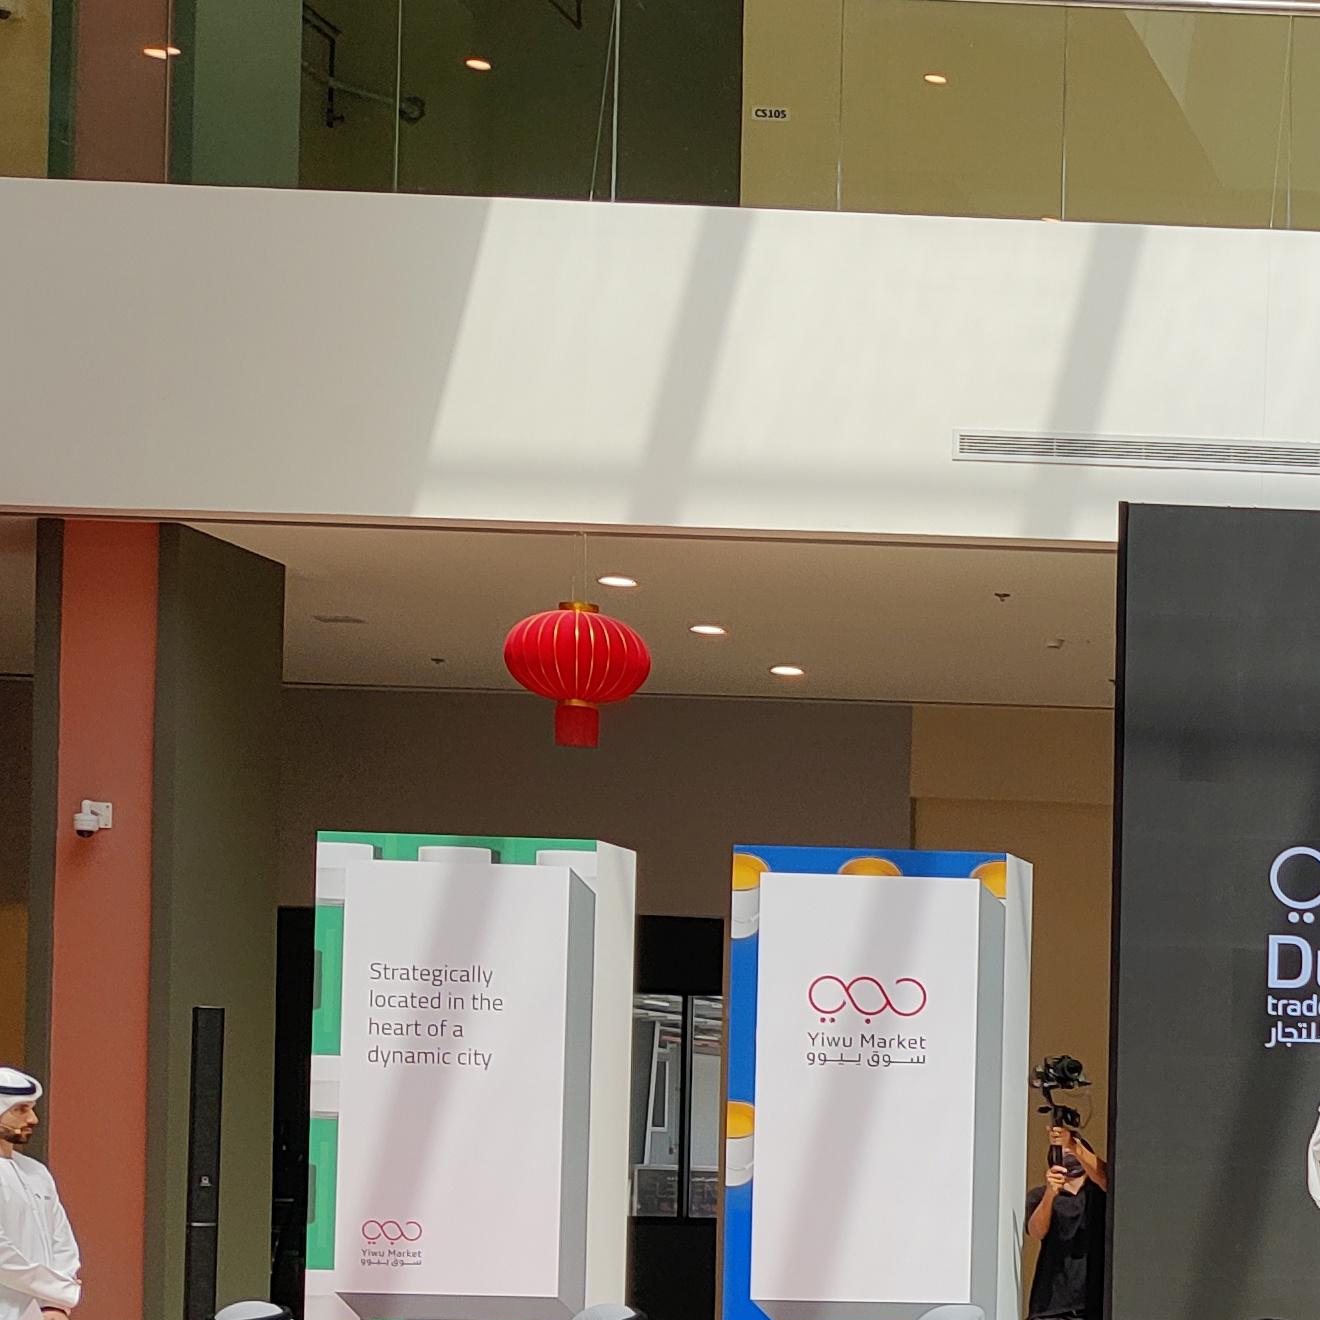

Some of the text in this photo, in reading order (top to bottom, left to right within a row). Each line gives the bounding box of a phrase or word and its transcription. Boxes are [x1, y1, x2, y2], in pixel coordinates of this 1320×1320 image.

[754, 108, 787, 118] CS105
[370, 962, 493, 988] Strategically
[369, 989, 503, 1011] located in the
[368, 1017, 464, 1038] heart of a
[807, 1032, 926, 1049] Yiwu Market
[368, 1045, 492, 1071] dynamic city
[867, 1051, 926, 1067] سوق
[361, 1249, 422, 1258] Yiwu Market
